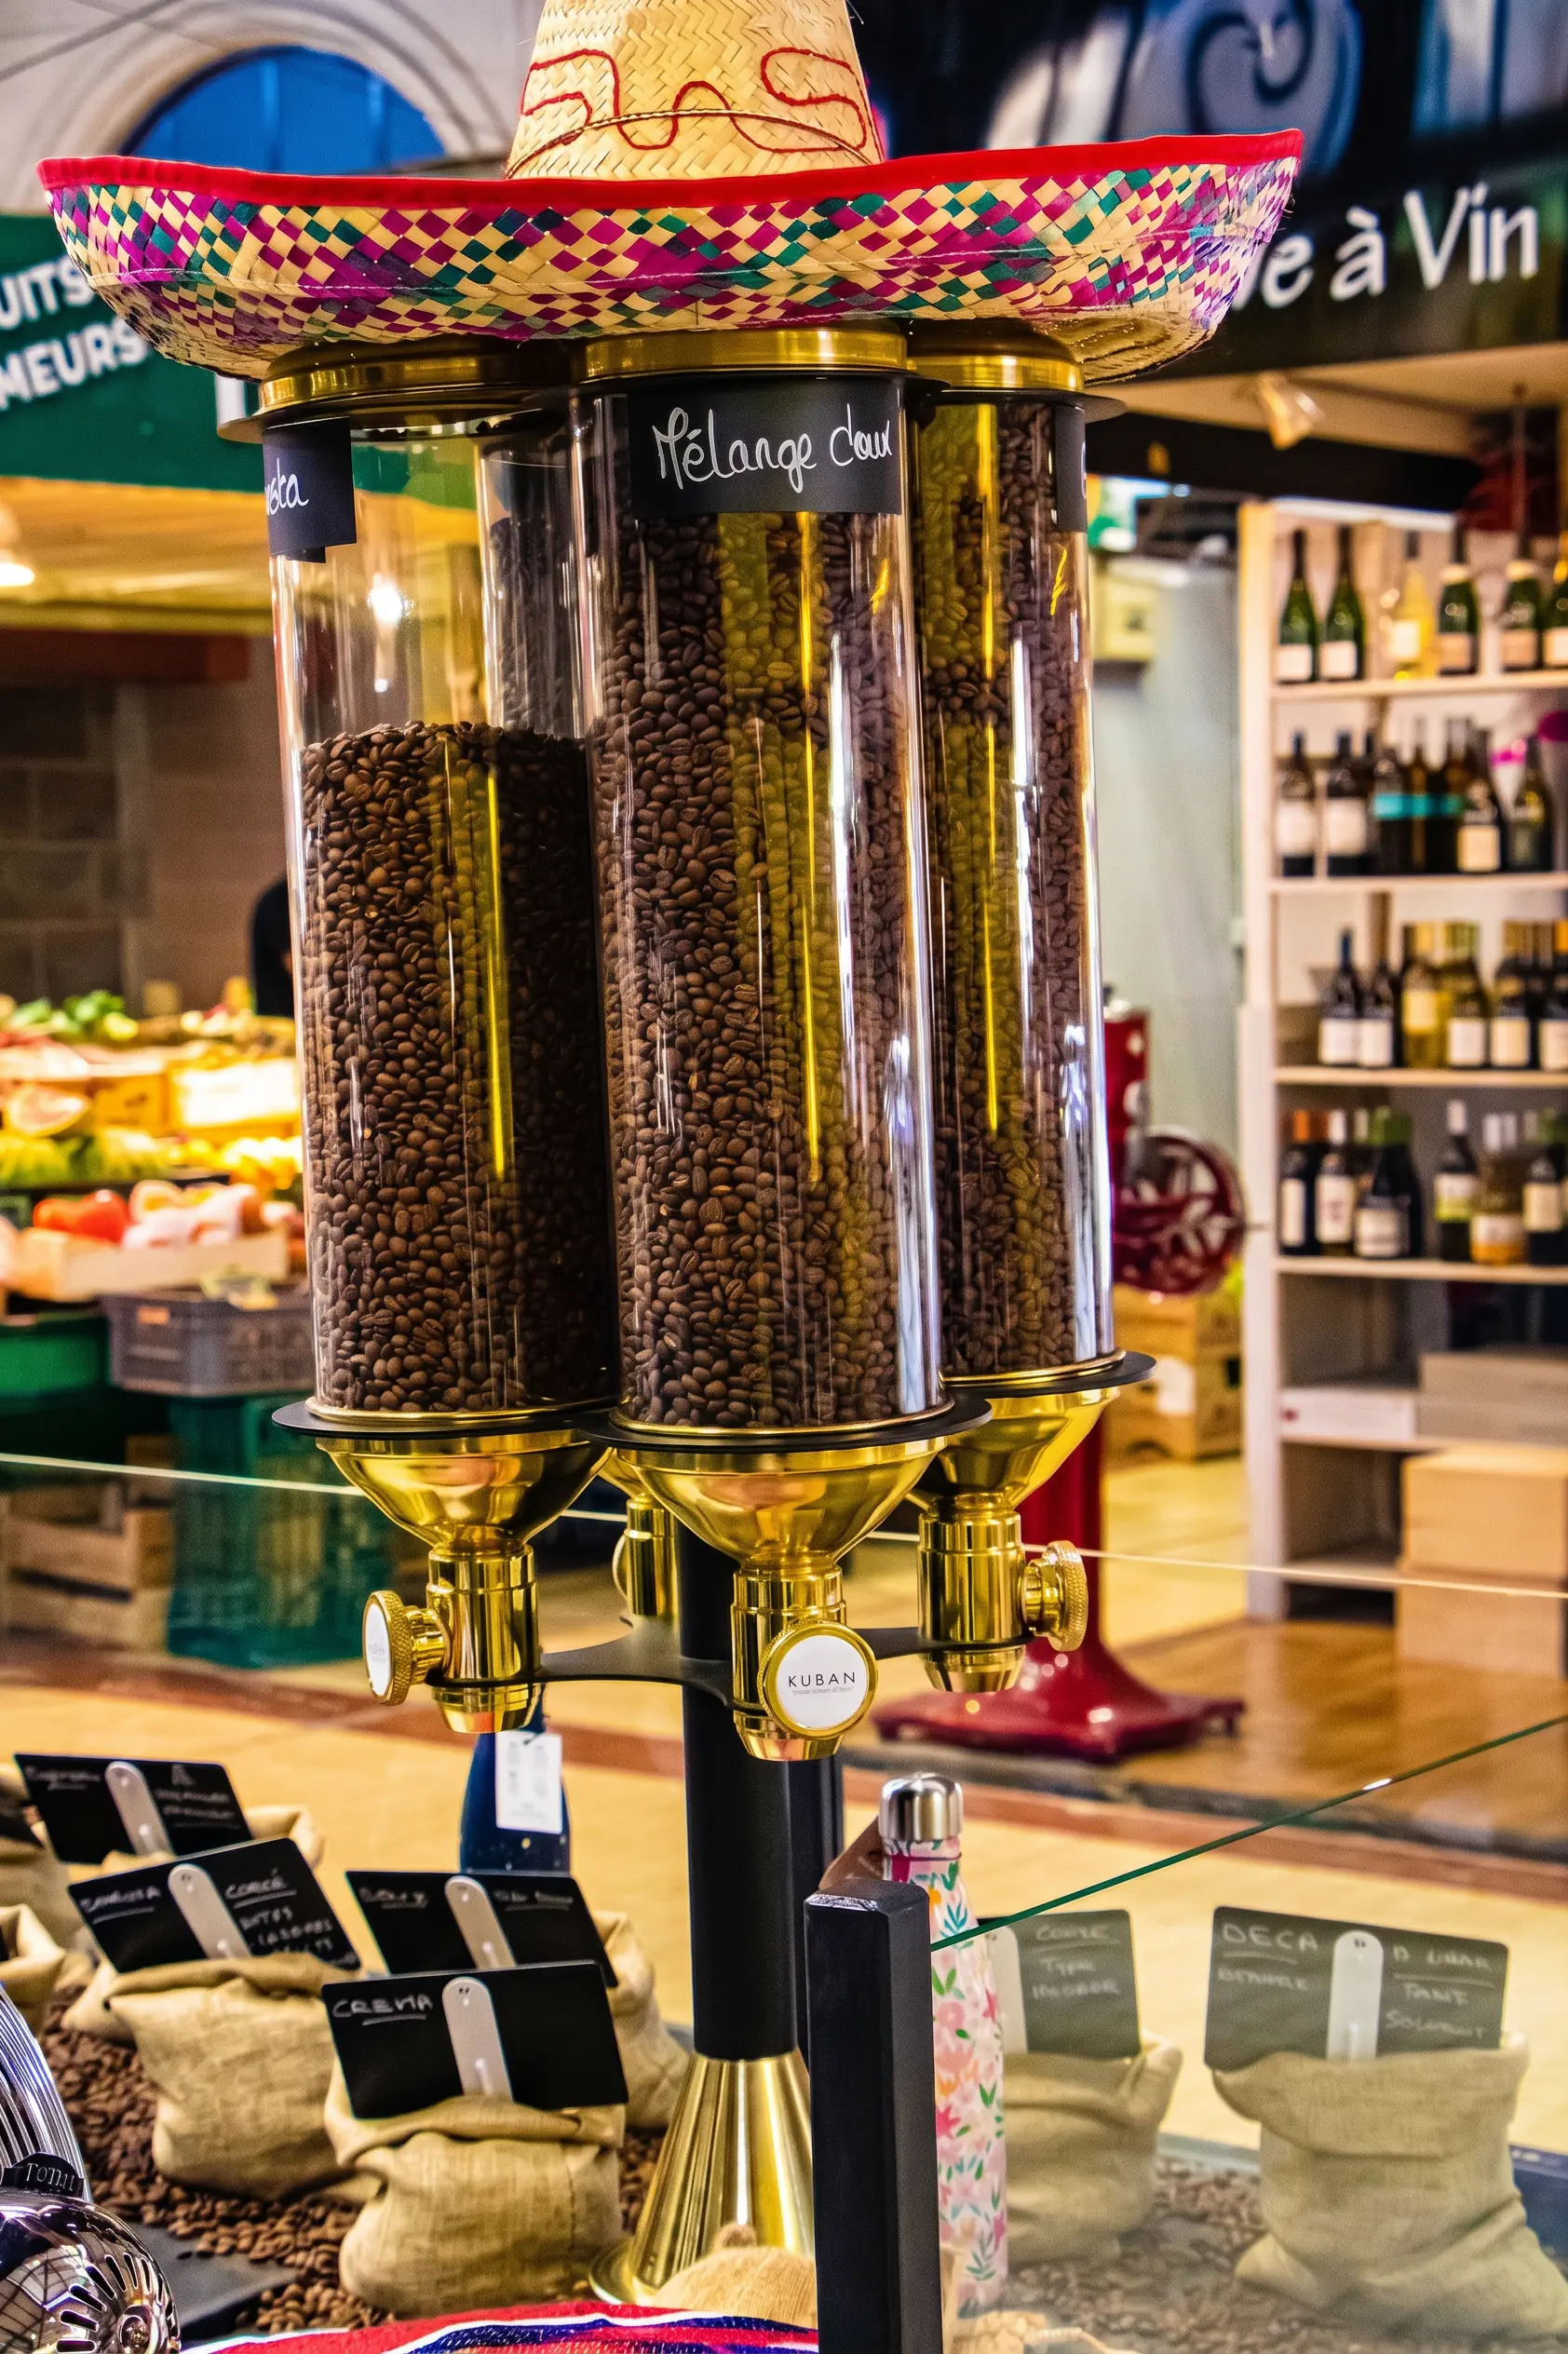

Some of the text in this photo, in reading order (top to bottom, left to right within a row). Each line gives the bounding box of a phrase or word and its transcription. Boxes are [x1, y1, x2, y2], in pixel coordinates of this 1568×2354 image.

[1330, 205, 1387, 303] à
[1403, 182, 1540, 289] Vin
[652, 406, 818, 494] Mélange
[788, 1671, 856, 1688] KUBAN
[331, 1994, 433, 2019] CREMA
